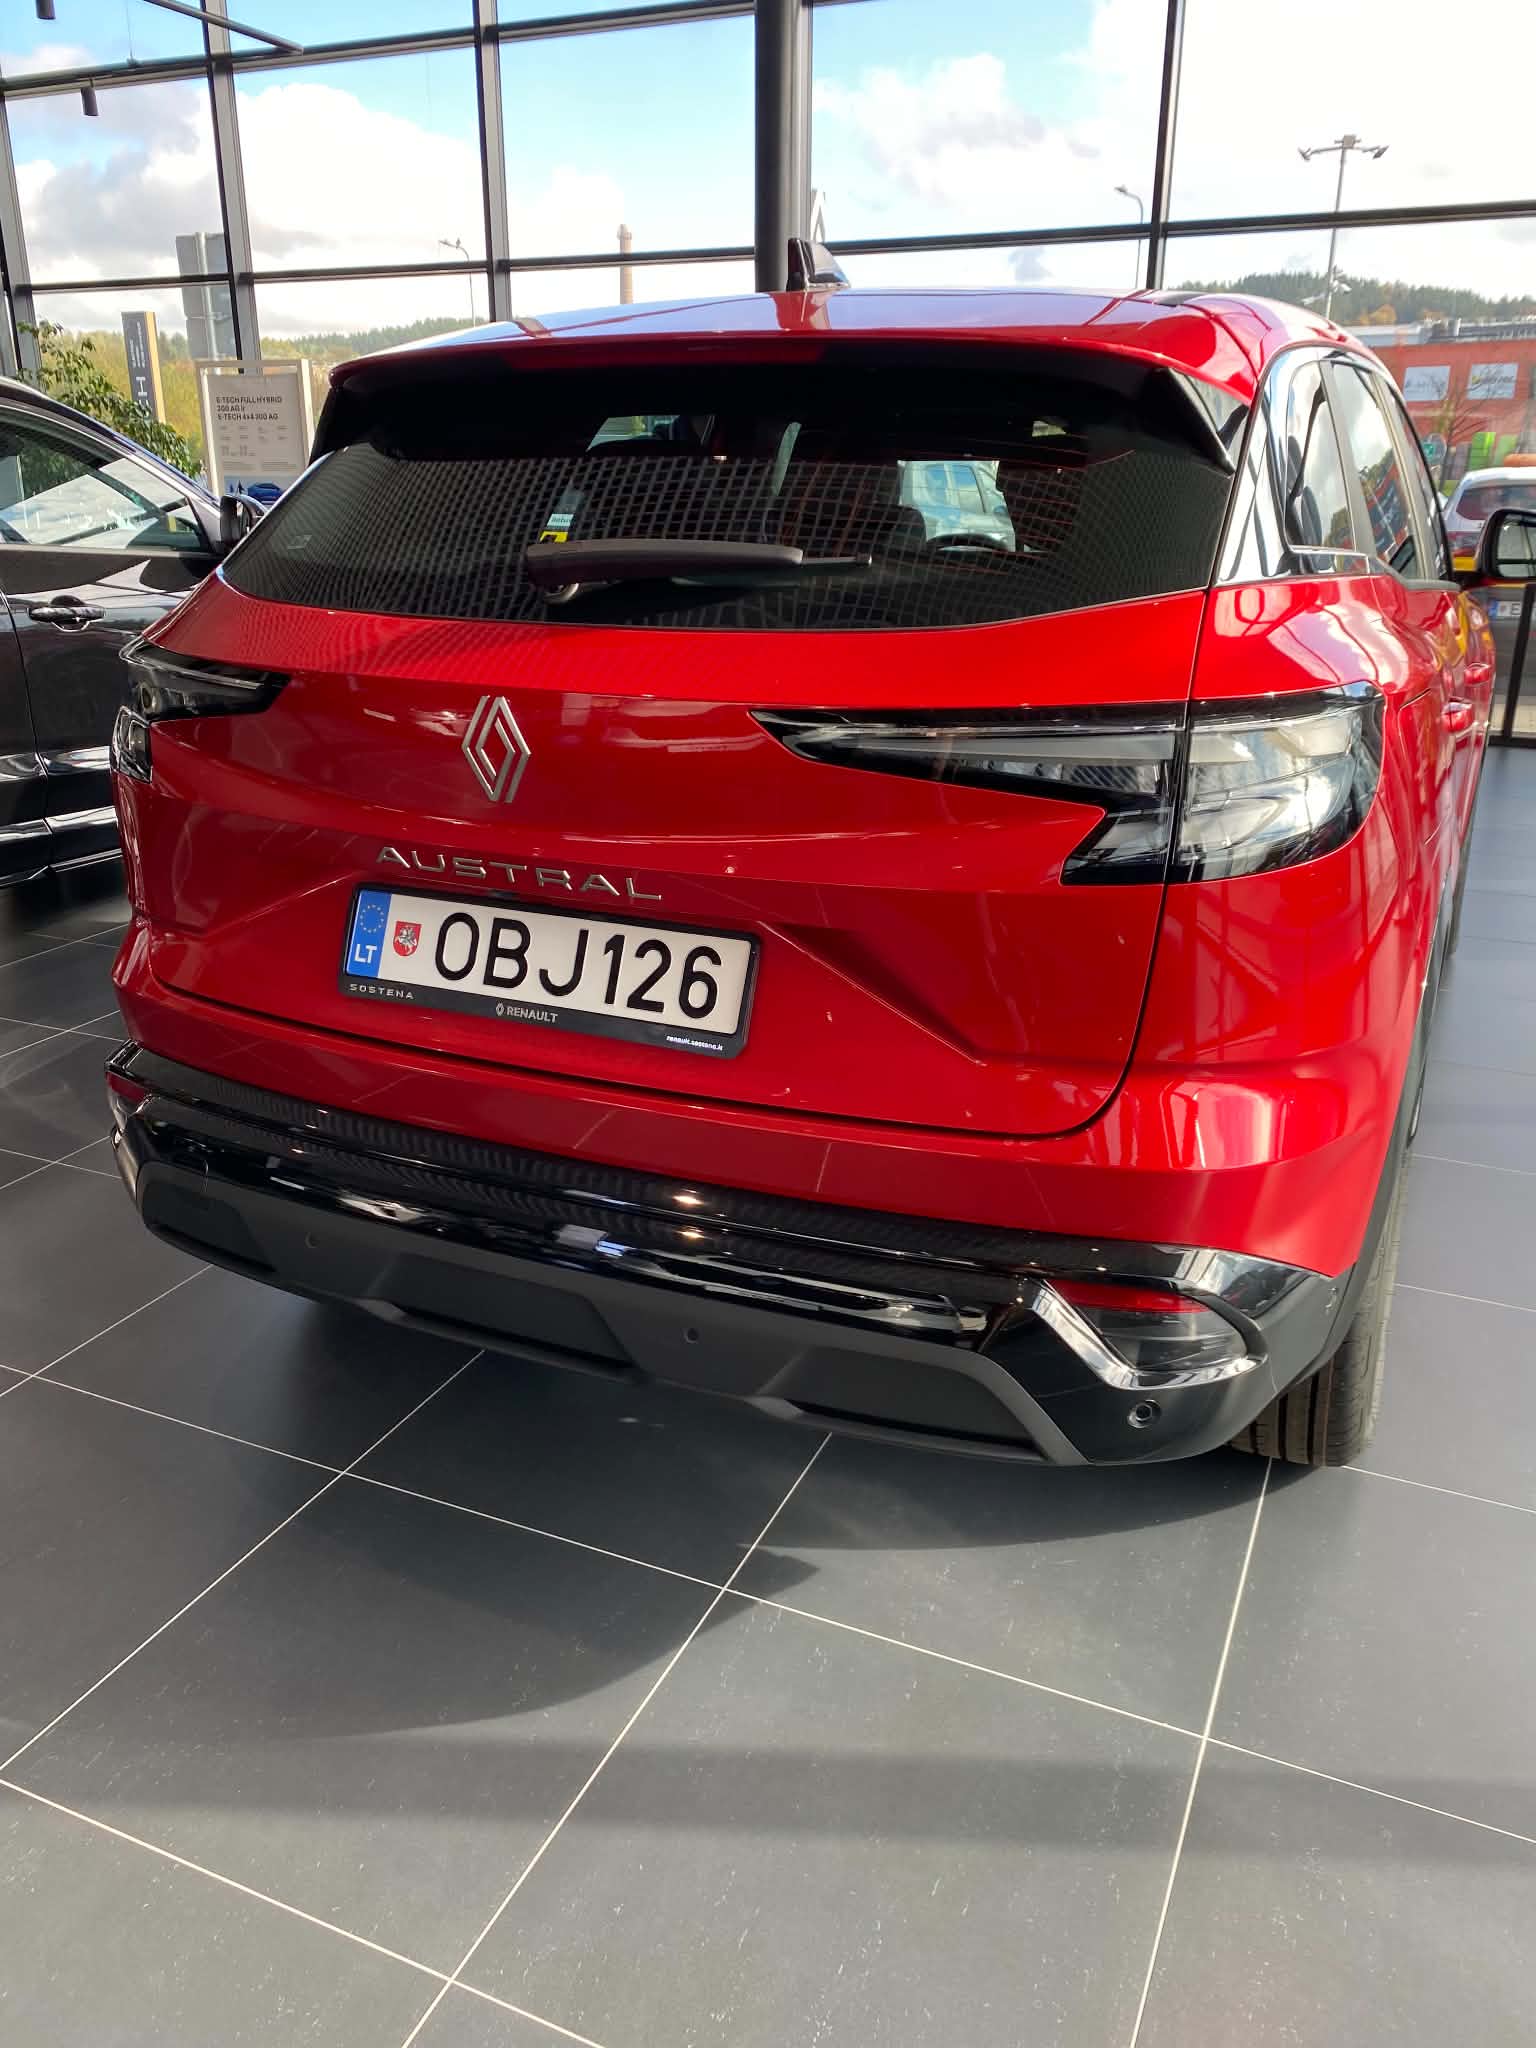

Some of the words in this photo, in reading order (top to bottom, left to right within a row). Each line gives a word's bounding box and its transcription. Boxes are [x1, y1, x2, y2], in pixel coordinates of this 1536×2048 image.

[375, 845, 662, 901] AUSTRAL
[353, 942, 378, 965] LT
[349, 983, 415, 1000] SOSTENA
[506, 1006, 559, 1023] RENAULT
